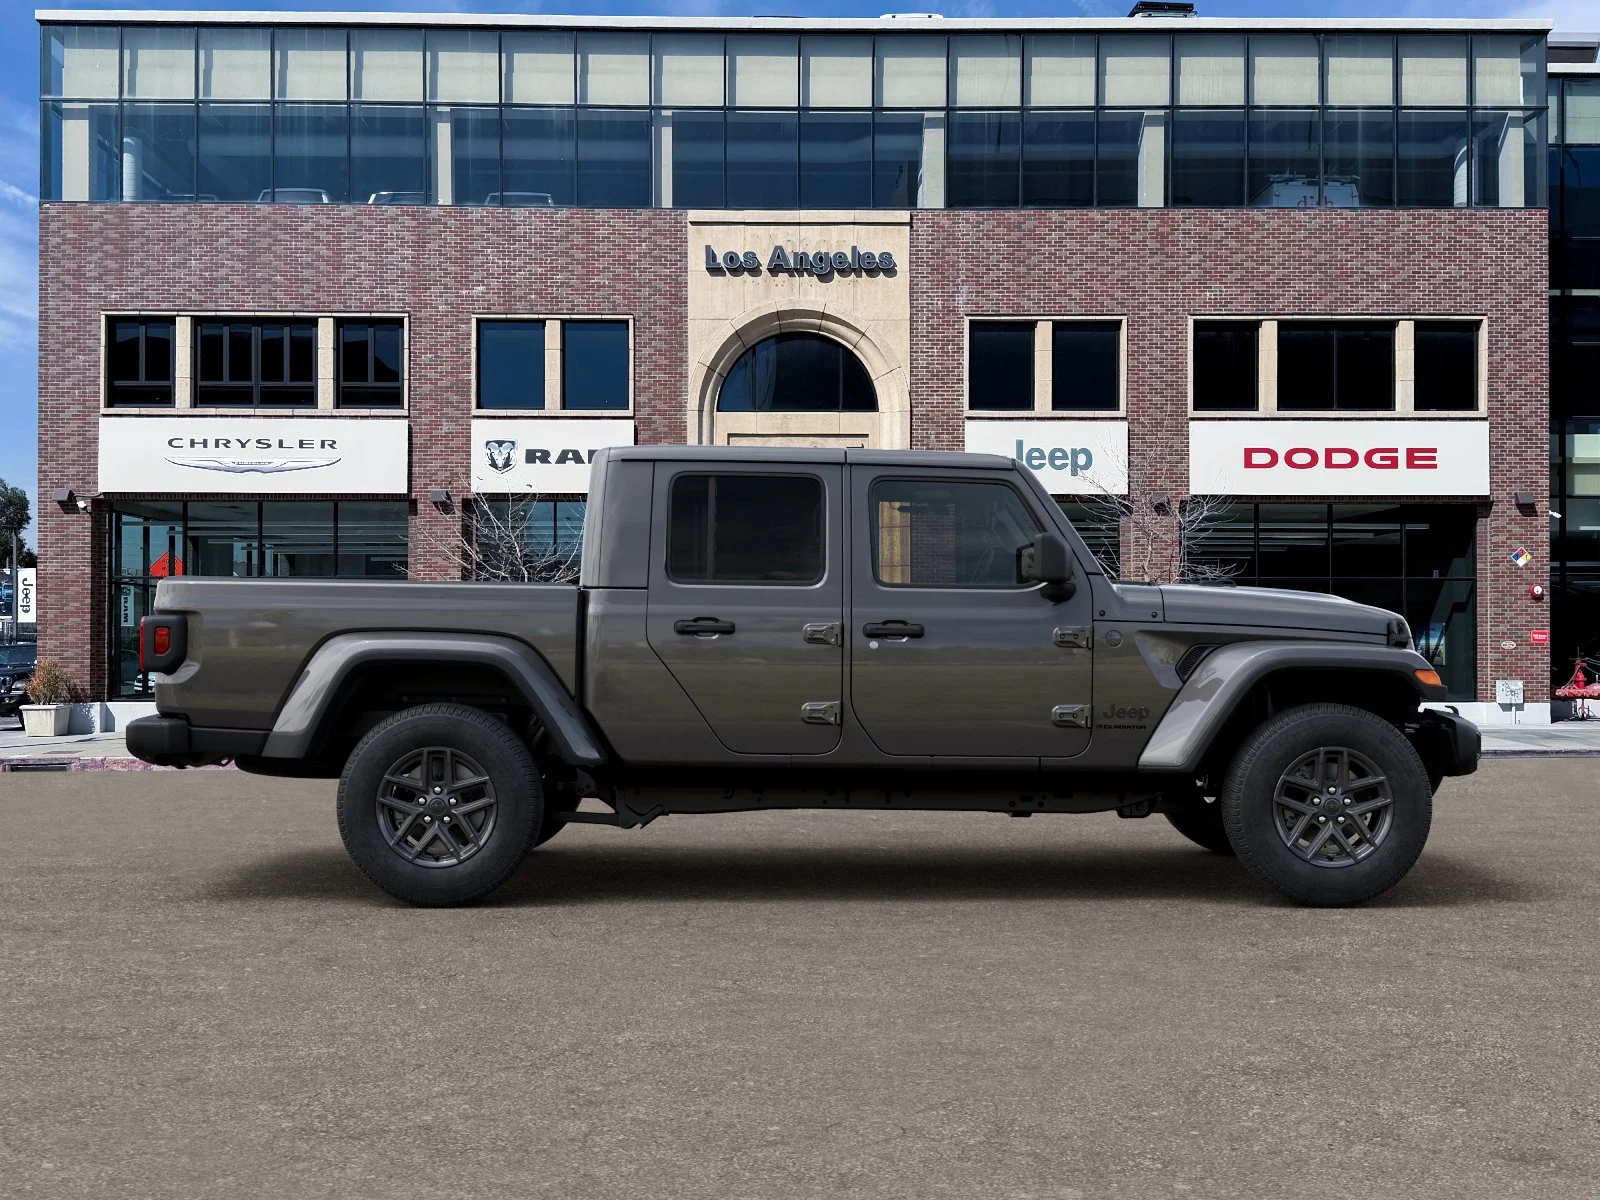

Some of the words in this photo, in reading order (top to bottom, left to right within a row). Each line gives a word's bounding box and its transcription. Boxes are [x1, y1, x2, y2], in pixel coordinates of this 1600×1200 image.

[704, 244, 759, 270] Los
[767, 245, 895, 275] Angeles
[167, 437, 338, 449] CHRYSLER
[525, 448, 598, 465] RA
[1243, 447, 1438, 469] DODGE
[20, 577, 33, 613] Jeep
[1103, 703, 1150, 721] Jeep
